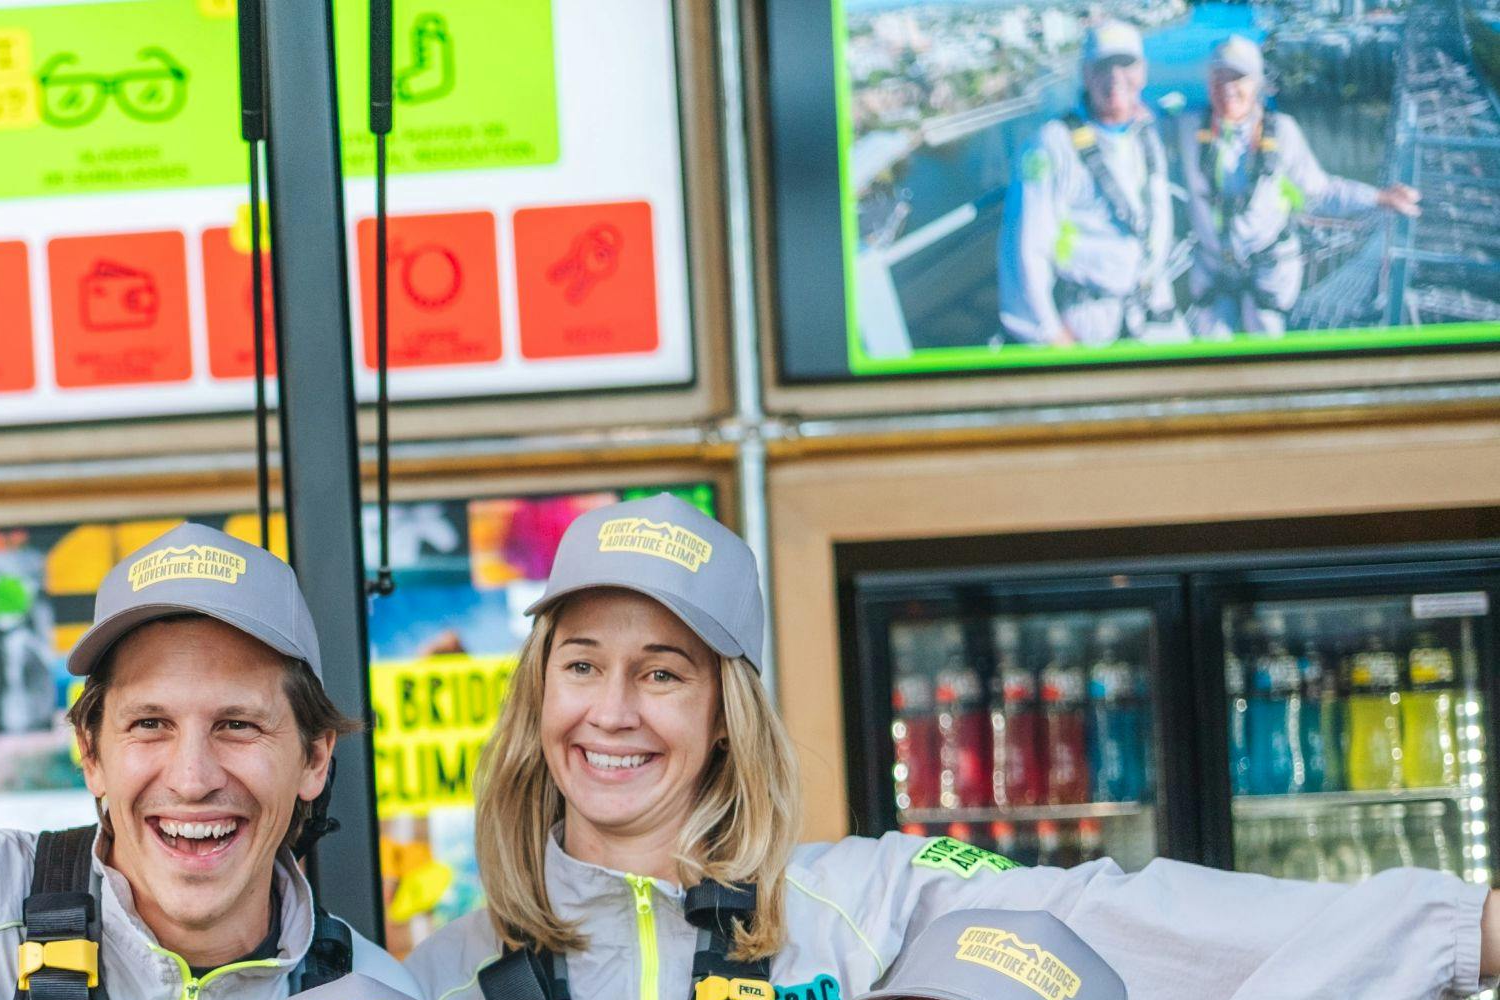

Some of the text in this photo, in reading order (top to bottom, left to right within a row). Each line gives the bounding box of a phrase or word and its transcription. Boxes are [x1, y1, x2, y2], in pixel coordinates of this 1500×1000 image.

[603, 521, 708, 557] STORY BRIDGE
[605, 535, 697, 566] ADVENTURE CLIMB
[132, 549, 240, 575] STORY BRIDGE
[137, 562, 232, 586] ADVENTURE CLIMB
[962, 944, 1061, 998] ADVENTURE CLIMB
[964, 929, 1076, 992] STORY BRIDGE
[739, 984, 765, 997] PETZL
